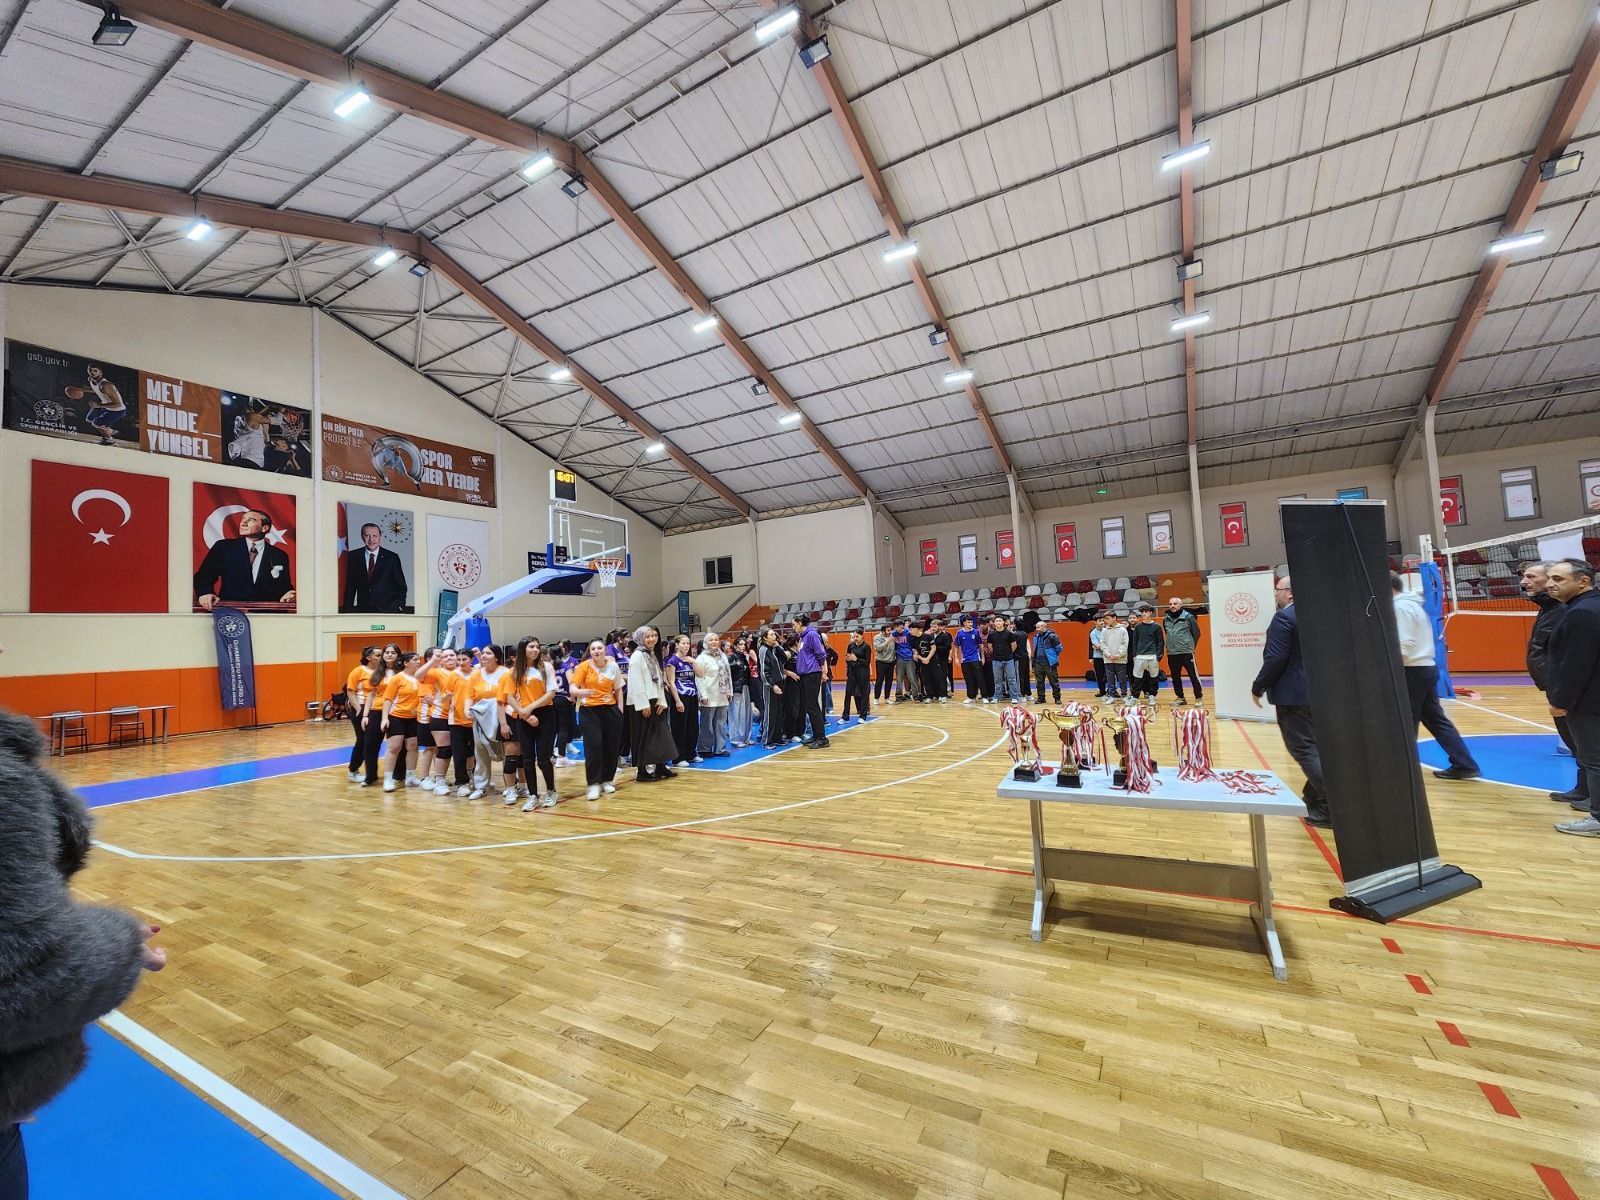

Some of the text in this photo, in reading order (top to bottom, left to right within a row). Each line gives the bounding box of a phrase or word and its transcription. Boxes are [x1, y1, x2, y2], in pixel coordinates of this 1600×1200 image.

[26, 352, 71, 368] gsb.gov.tr
[20, 423, 40, 431] SPOR
[146, 403, 199, 434] KİNDE
[323, 421, 364, 438] ON BİN POTA
[146, 429, 213, 460] YÜKSEL
[420, 448, 453, 470] SPOR
[421, 466, 480, 492] HER YERDE
